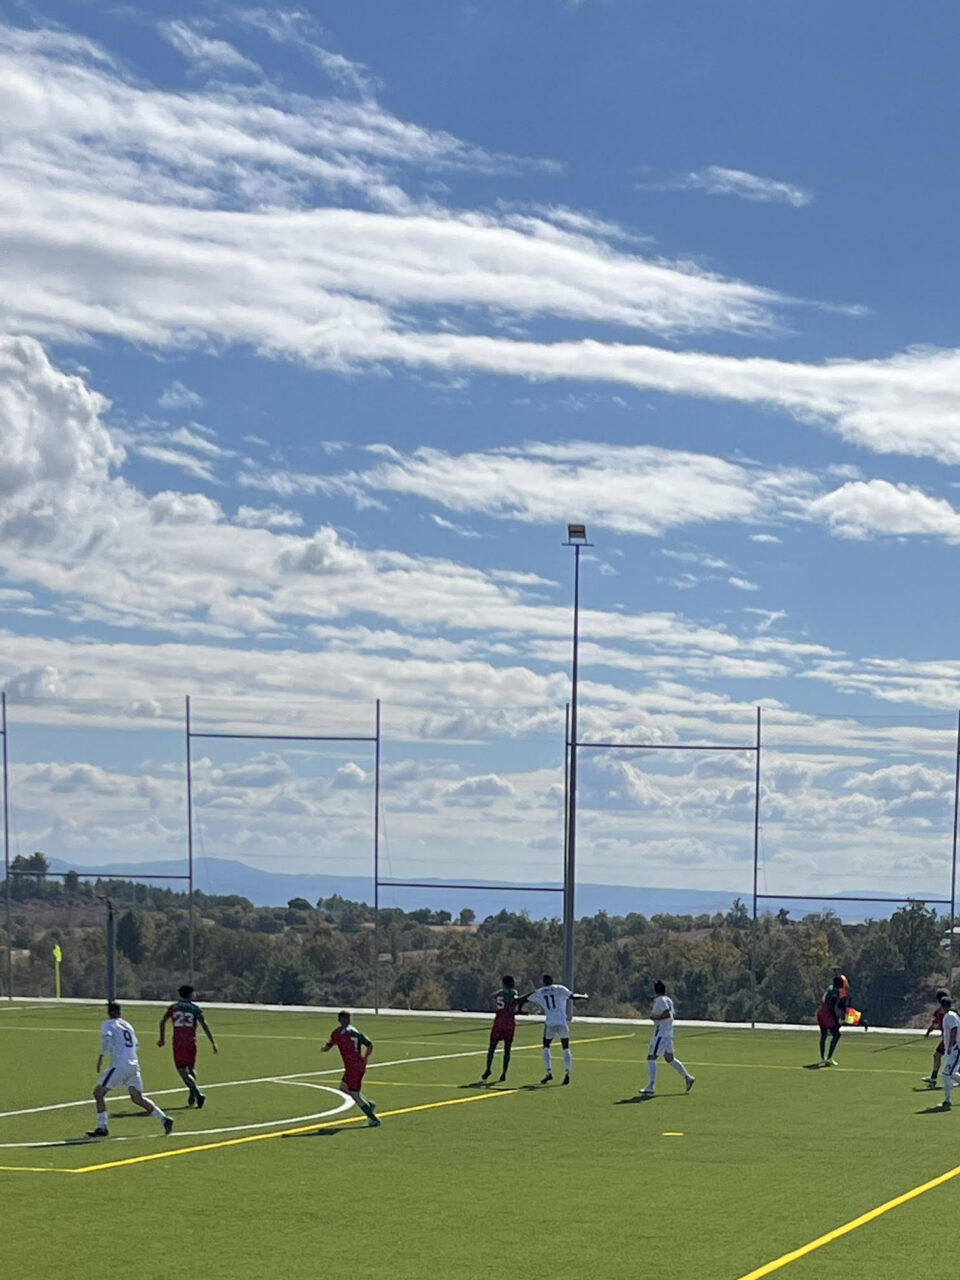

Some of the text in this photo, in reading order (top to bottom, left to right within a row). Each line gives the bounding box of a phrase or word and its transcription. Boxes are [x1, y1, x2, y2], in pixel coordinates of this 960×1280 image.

[544, 994, 556, 1010] 11
[173, 1011, 195, 1027] 23
[123, 1030, 133, 1048] 9
[351, 1037, 359, 1051] 7
